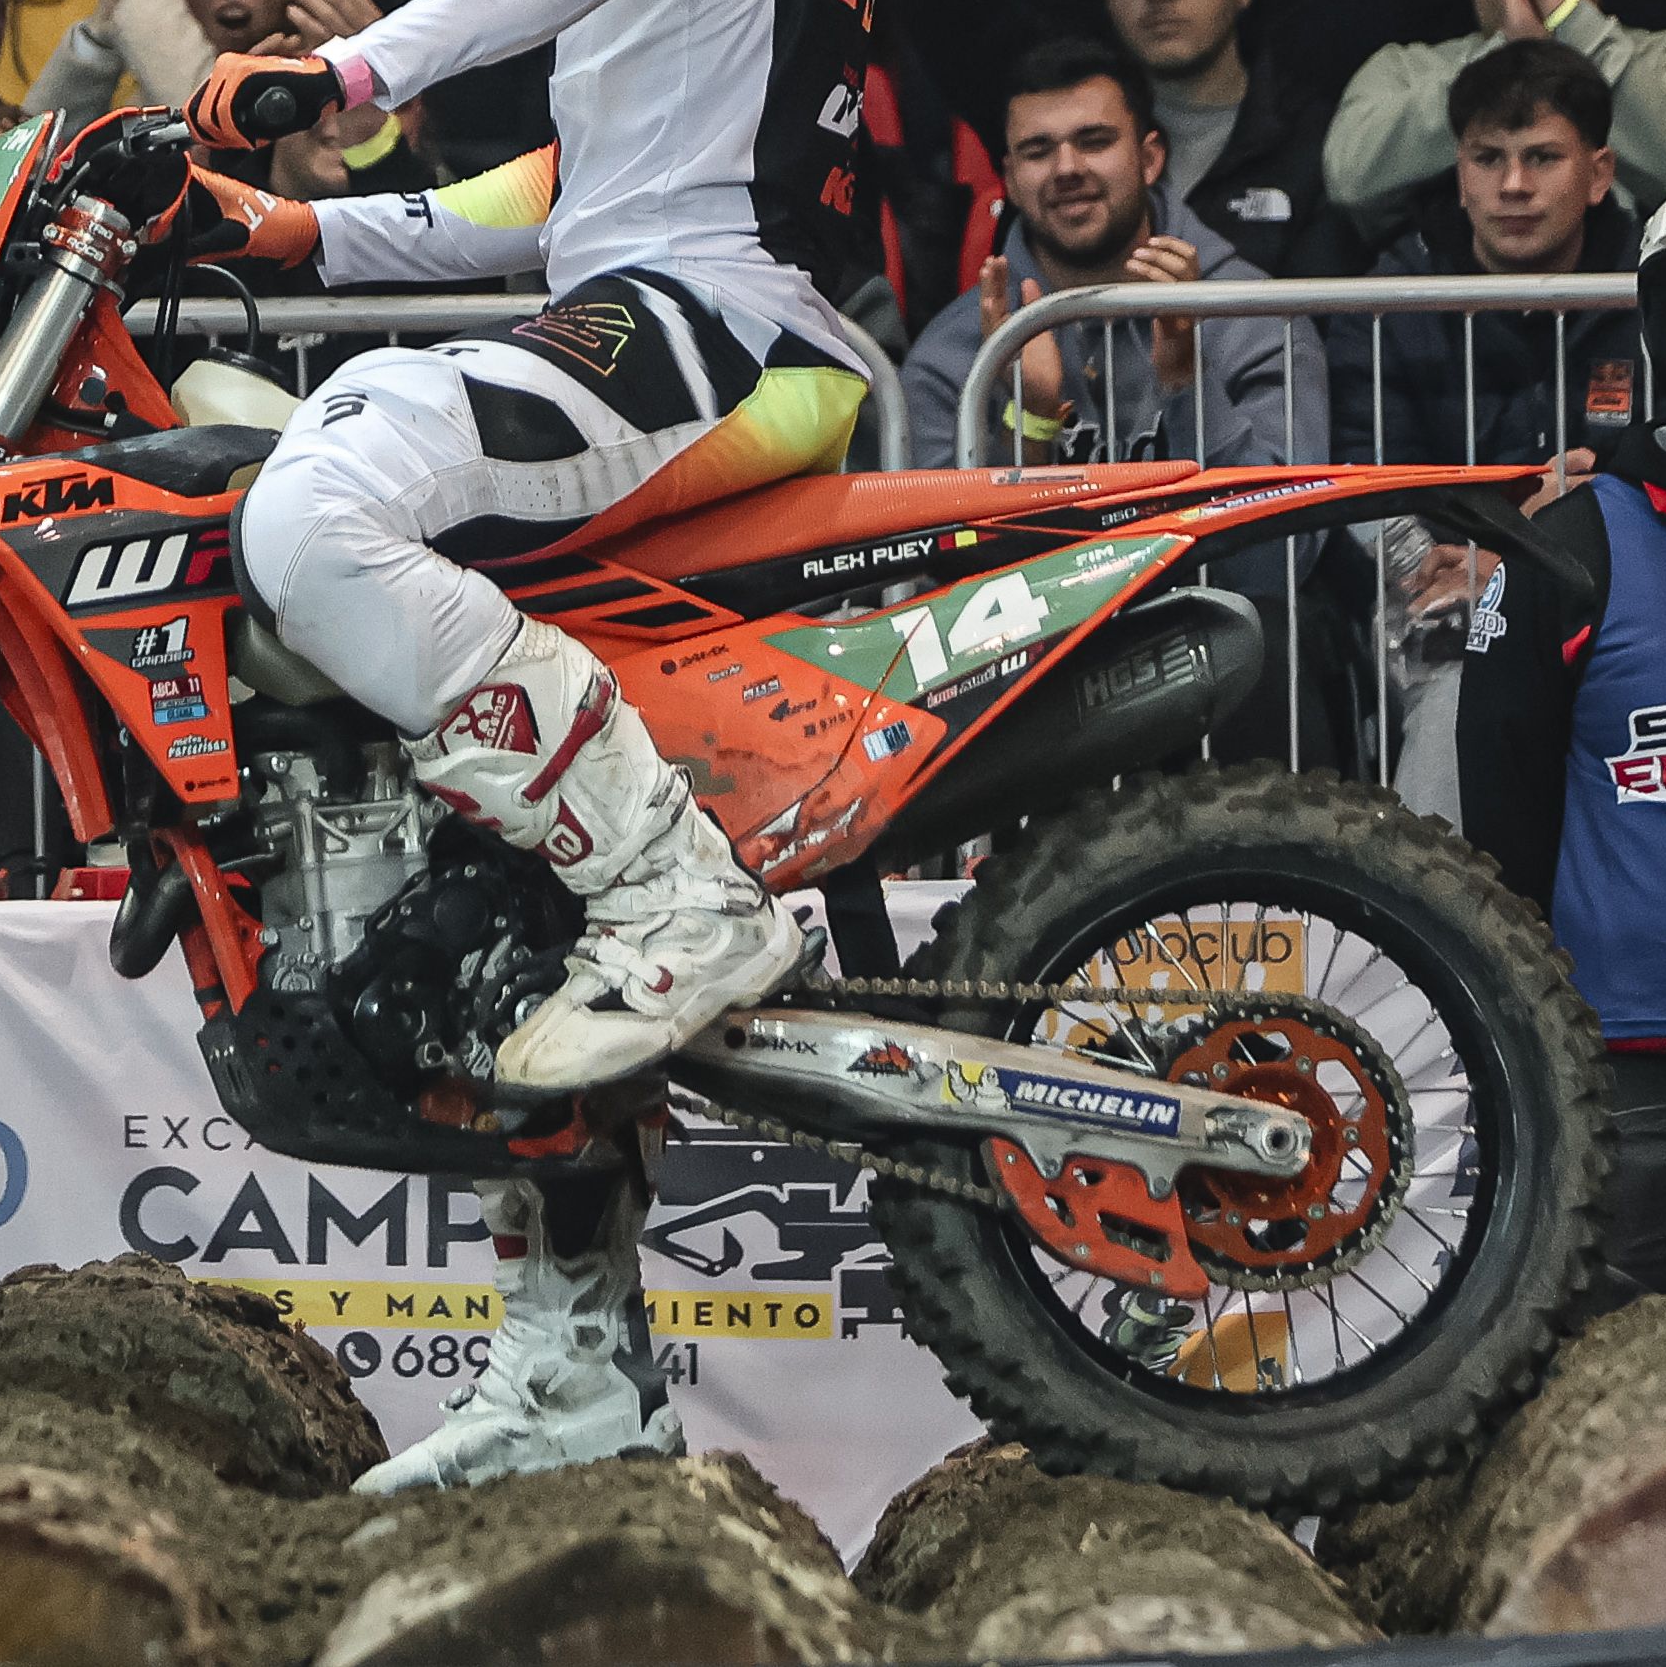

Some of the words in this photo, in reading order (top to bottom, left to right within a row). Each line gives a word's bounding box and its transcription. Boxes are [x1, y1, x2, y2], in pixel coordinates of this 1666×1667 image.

[1, 473, 115, 523] KTM
[872, 537, 933, 565] PUEY
[890, 571, 1050, 684] 14
[1015, 1079, 1176, 1126] MICHELIN
[329, 1290, 351, 1316] Y
